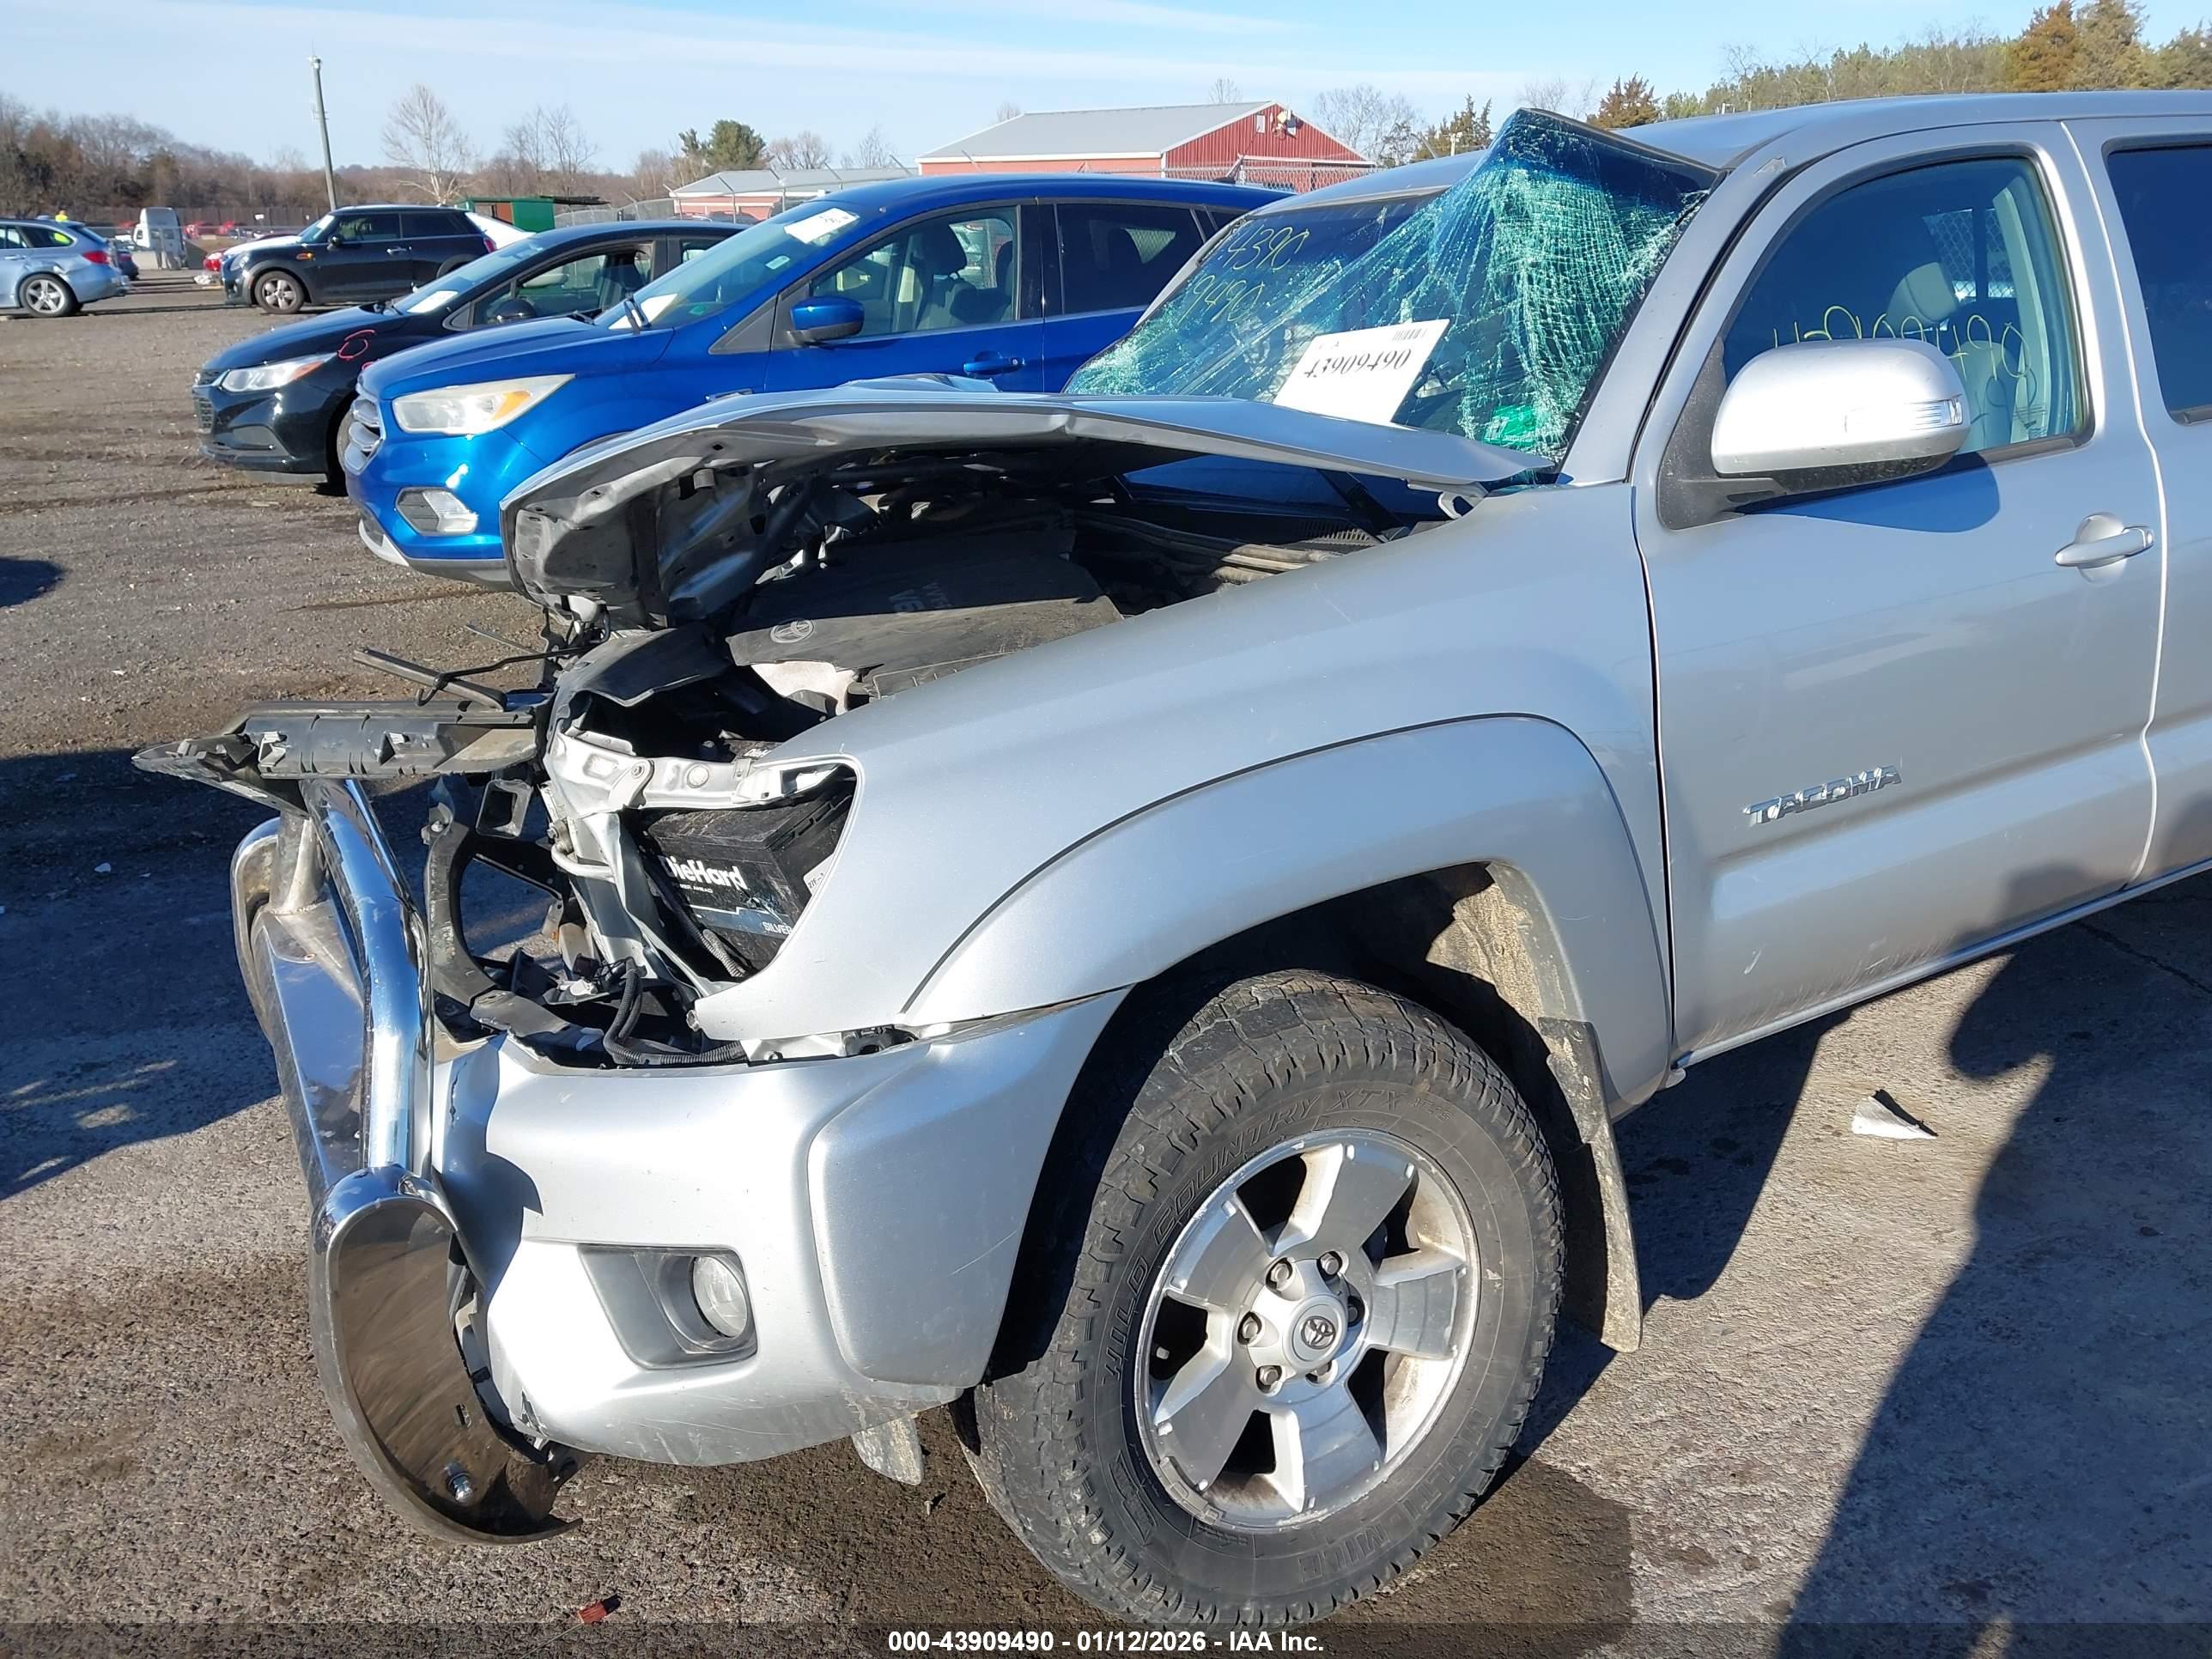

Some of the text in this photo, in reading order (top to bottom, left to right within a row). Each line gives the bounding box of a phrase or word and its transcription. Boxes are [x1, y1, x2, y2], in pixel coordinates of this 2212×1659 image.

[1742, 764, 1902, 827] TACOMA
[658, 855, 750, 891] DieHard
[763, 921, 793, 935] SILVER
[1152, 1095, 1321, 1245] COUNTRY
[1328, 1090, 1407, 1111] XTX
